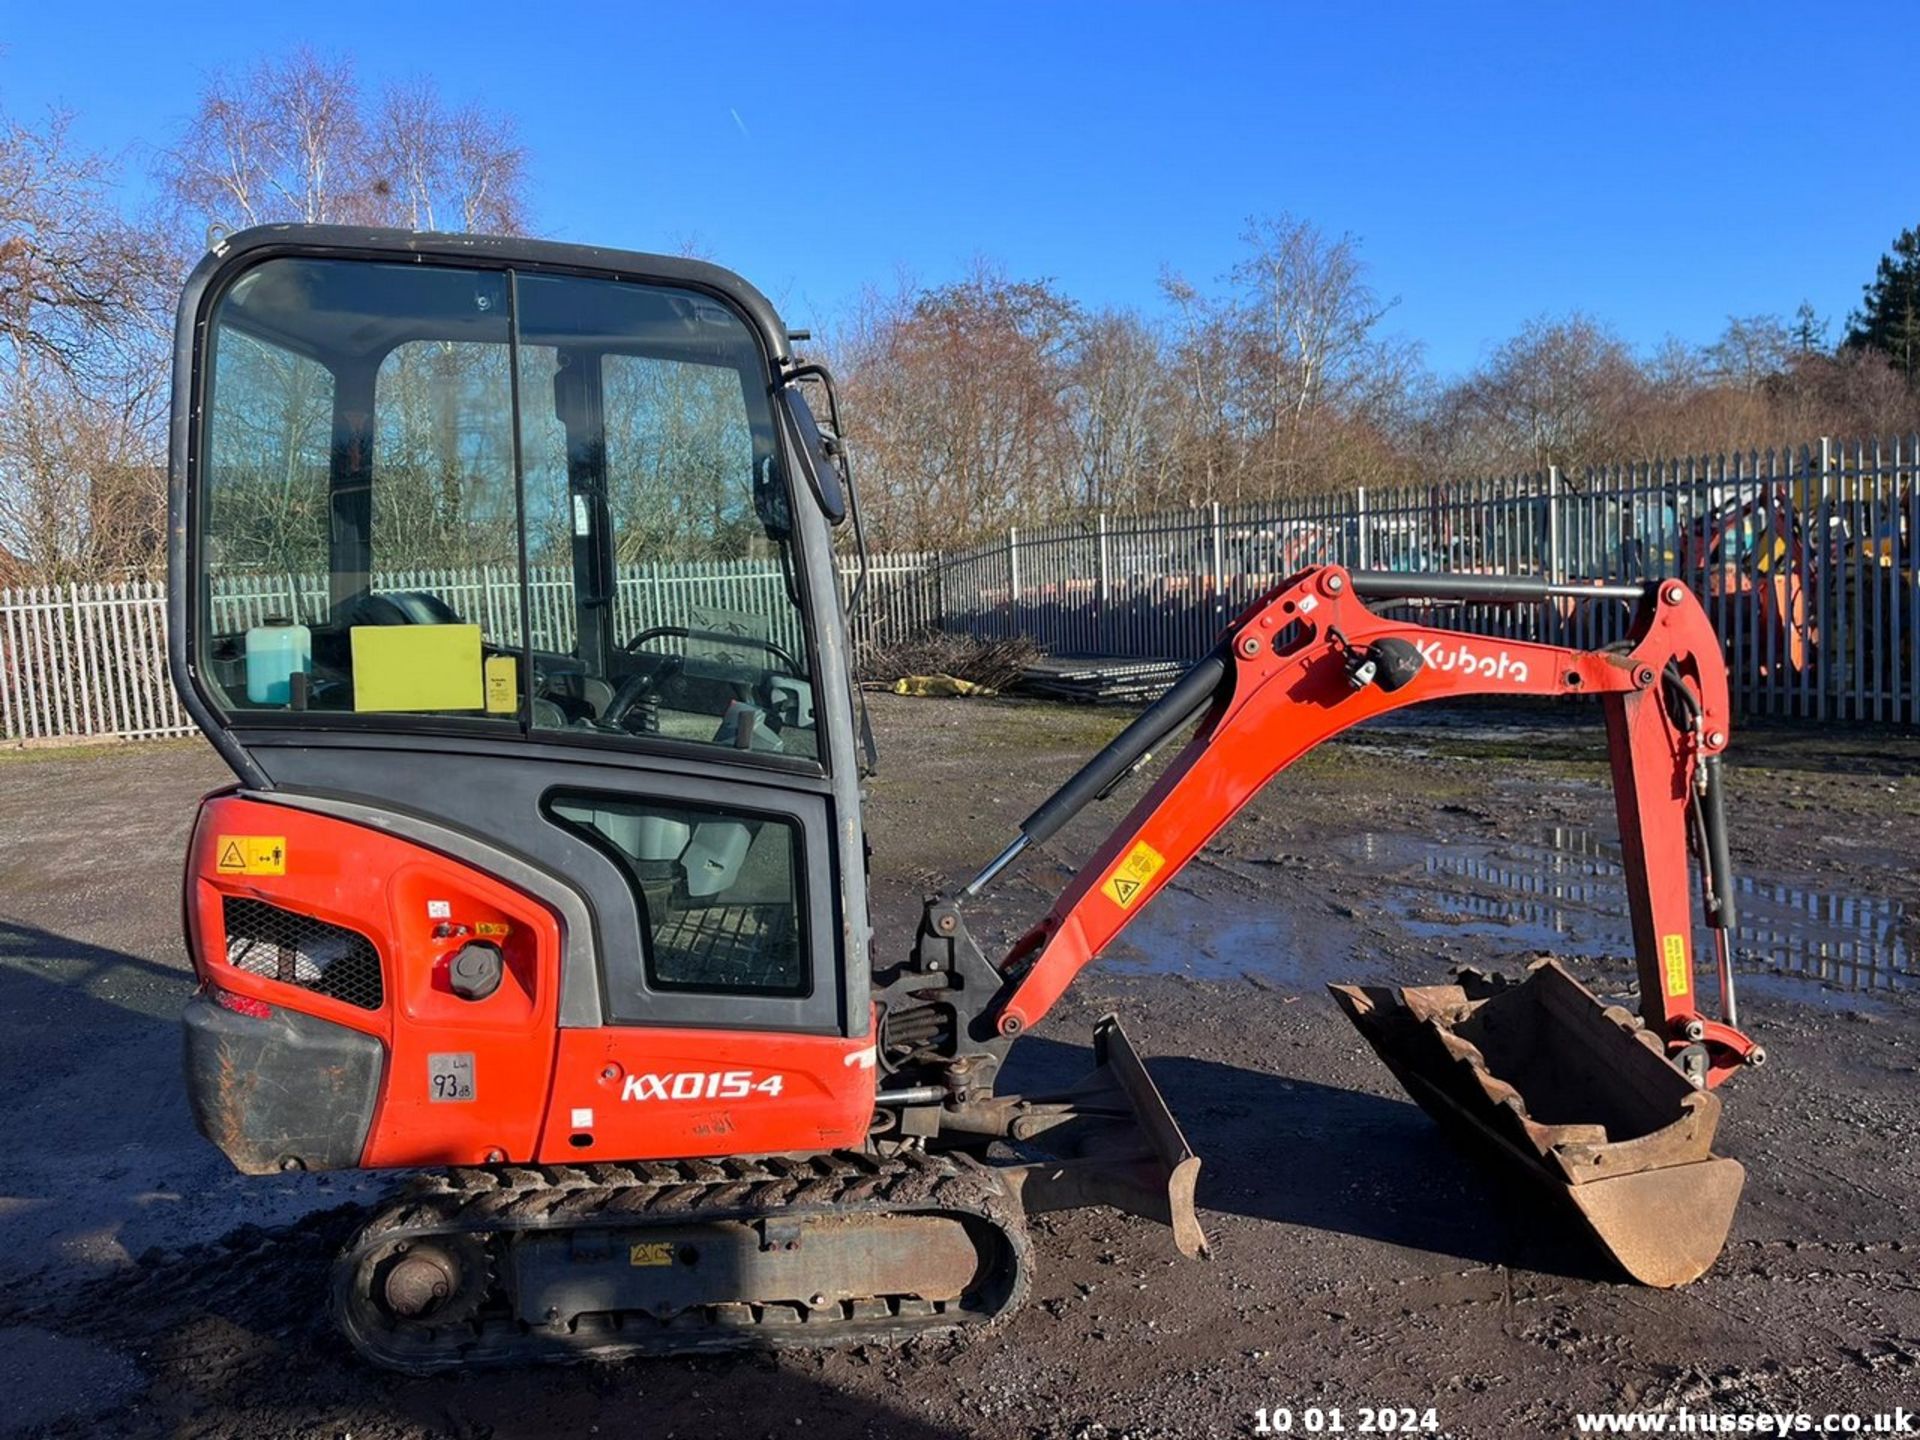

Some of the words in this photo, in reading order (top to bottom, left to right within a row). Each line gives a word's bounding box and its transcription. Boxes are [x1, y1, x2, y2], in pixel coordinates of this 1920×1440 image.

[1415, 639, 1529, 683] Kubota
[433, 1074, 457, 1098] 93
[621, 1071, 783, 1100] KX015-4
